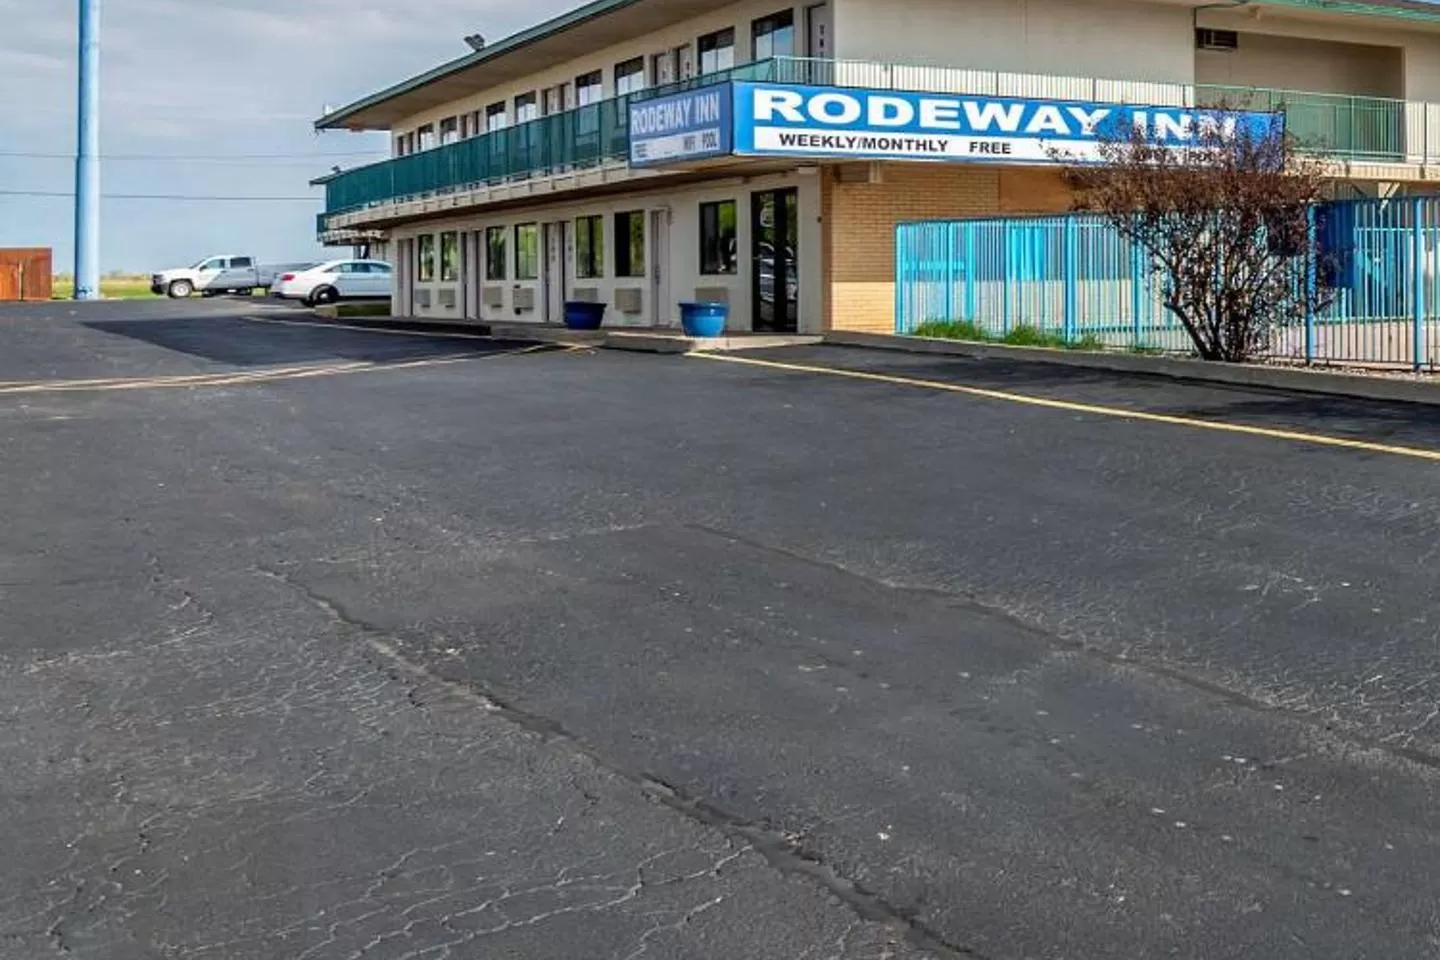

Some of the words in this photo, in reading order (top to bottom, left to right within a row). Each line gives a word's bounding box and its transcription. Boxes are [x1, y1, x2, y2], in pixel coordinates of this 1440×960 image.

[630, 97, 691, 136] RODEWAY
[695, 91, 719, 124] INN
[753, 89, 1112, 137] RODEWAY
[1132, 110, 1237, 146] INN
[779, 132, 948, 152] WEEKLY/MONTHLY
[969, 141, 1012, 155] FREE
